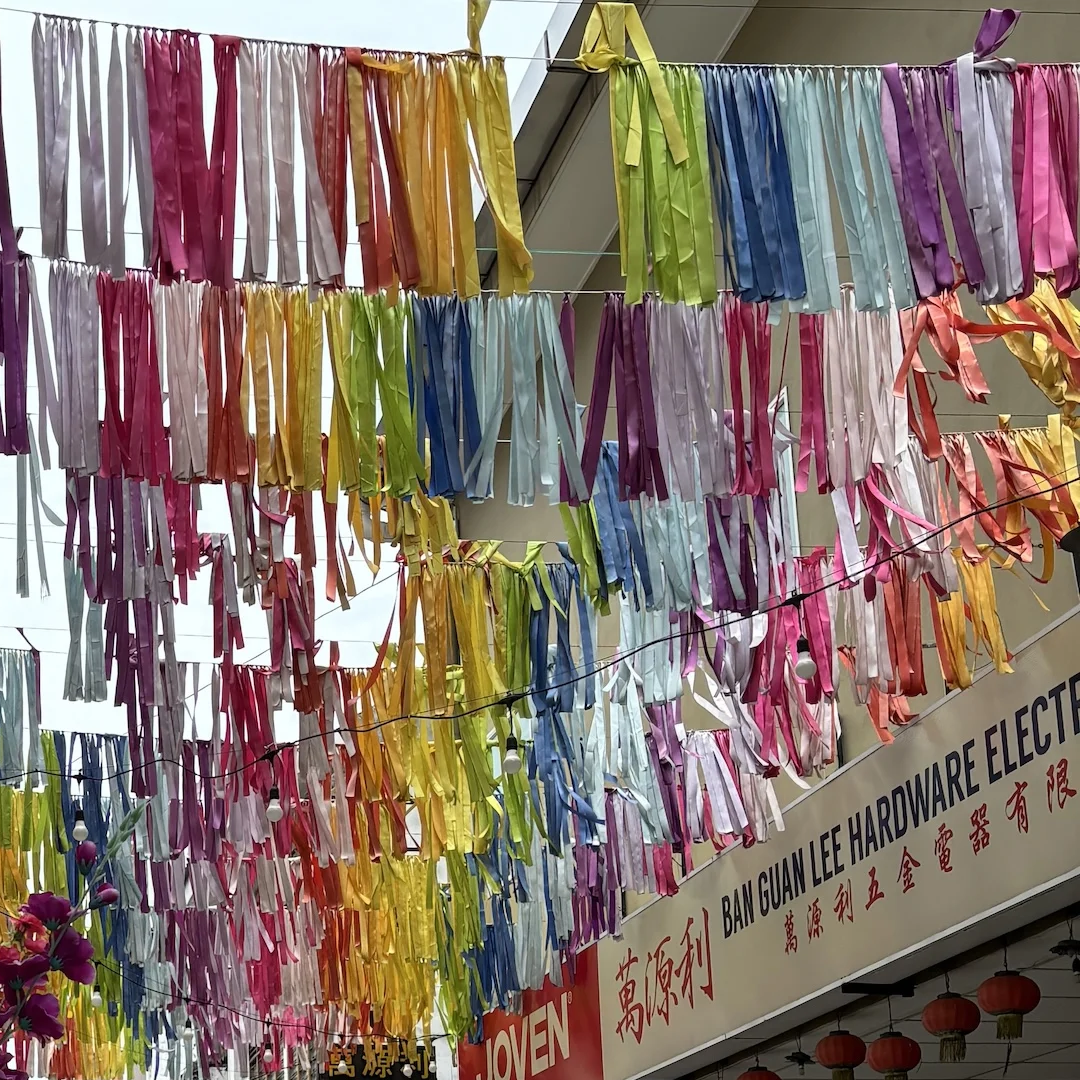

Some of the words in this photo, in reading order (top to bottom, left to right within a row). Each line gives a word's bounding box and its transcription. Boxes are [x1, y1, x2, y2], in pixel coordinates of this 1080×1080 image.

[721, 879, 755, 940] BAN
[758, 847, 806, 917] GUAN
[809, 824, 845, 888] LEE
[847, 738, 980, 866] HARDWARE
[615, 906, 714, 1046] 萬源利
